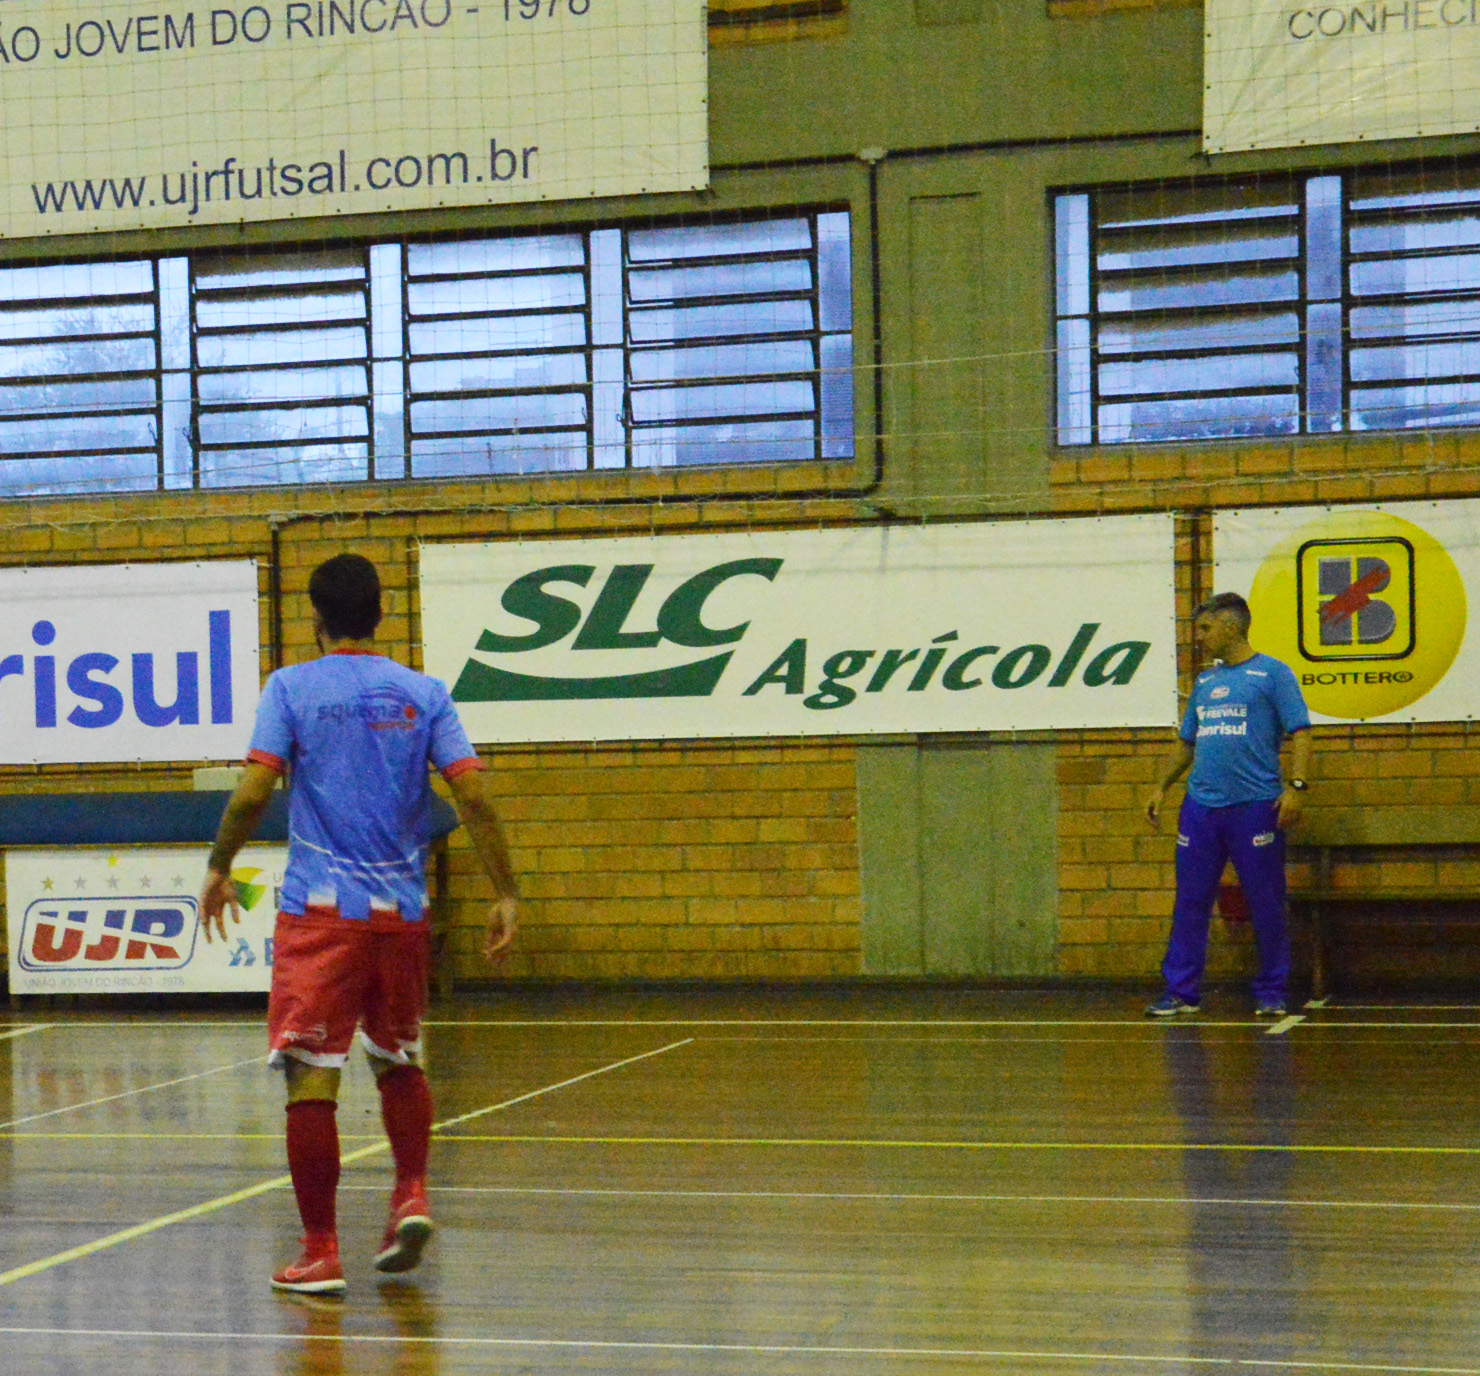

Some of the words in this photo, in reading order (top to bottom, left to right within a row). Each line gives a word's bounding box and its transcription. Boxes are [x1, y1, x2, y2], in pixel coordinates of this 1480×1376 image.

[54, 15, 197, 60] JOVEM
[212, 6, 282, 47] DO
[31, 138, 539, 214] www.ujrfutsal.com.br
[474, 557, 785, 653] SLC
[742, 623, 1151, 710] Agrícola
[32, 909, 184, 962] UJR
